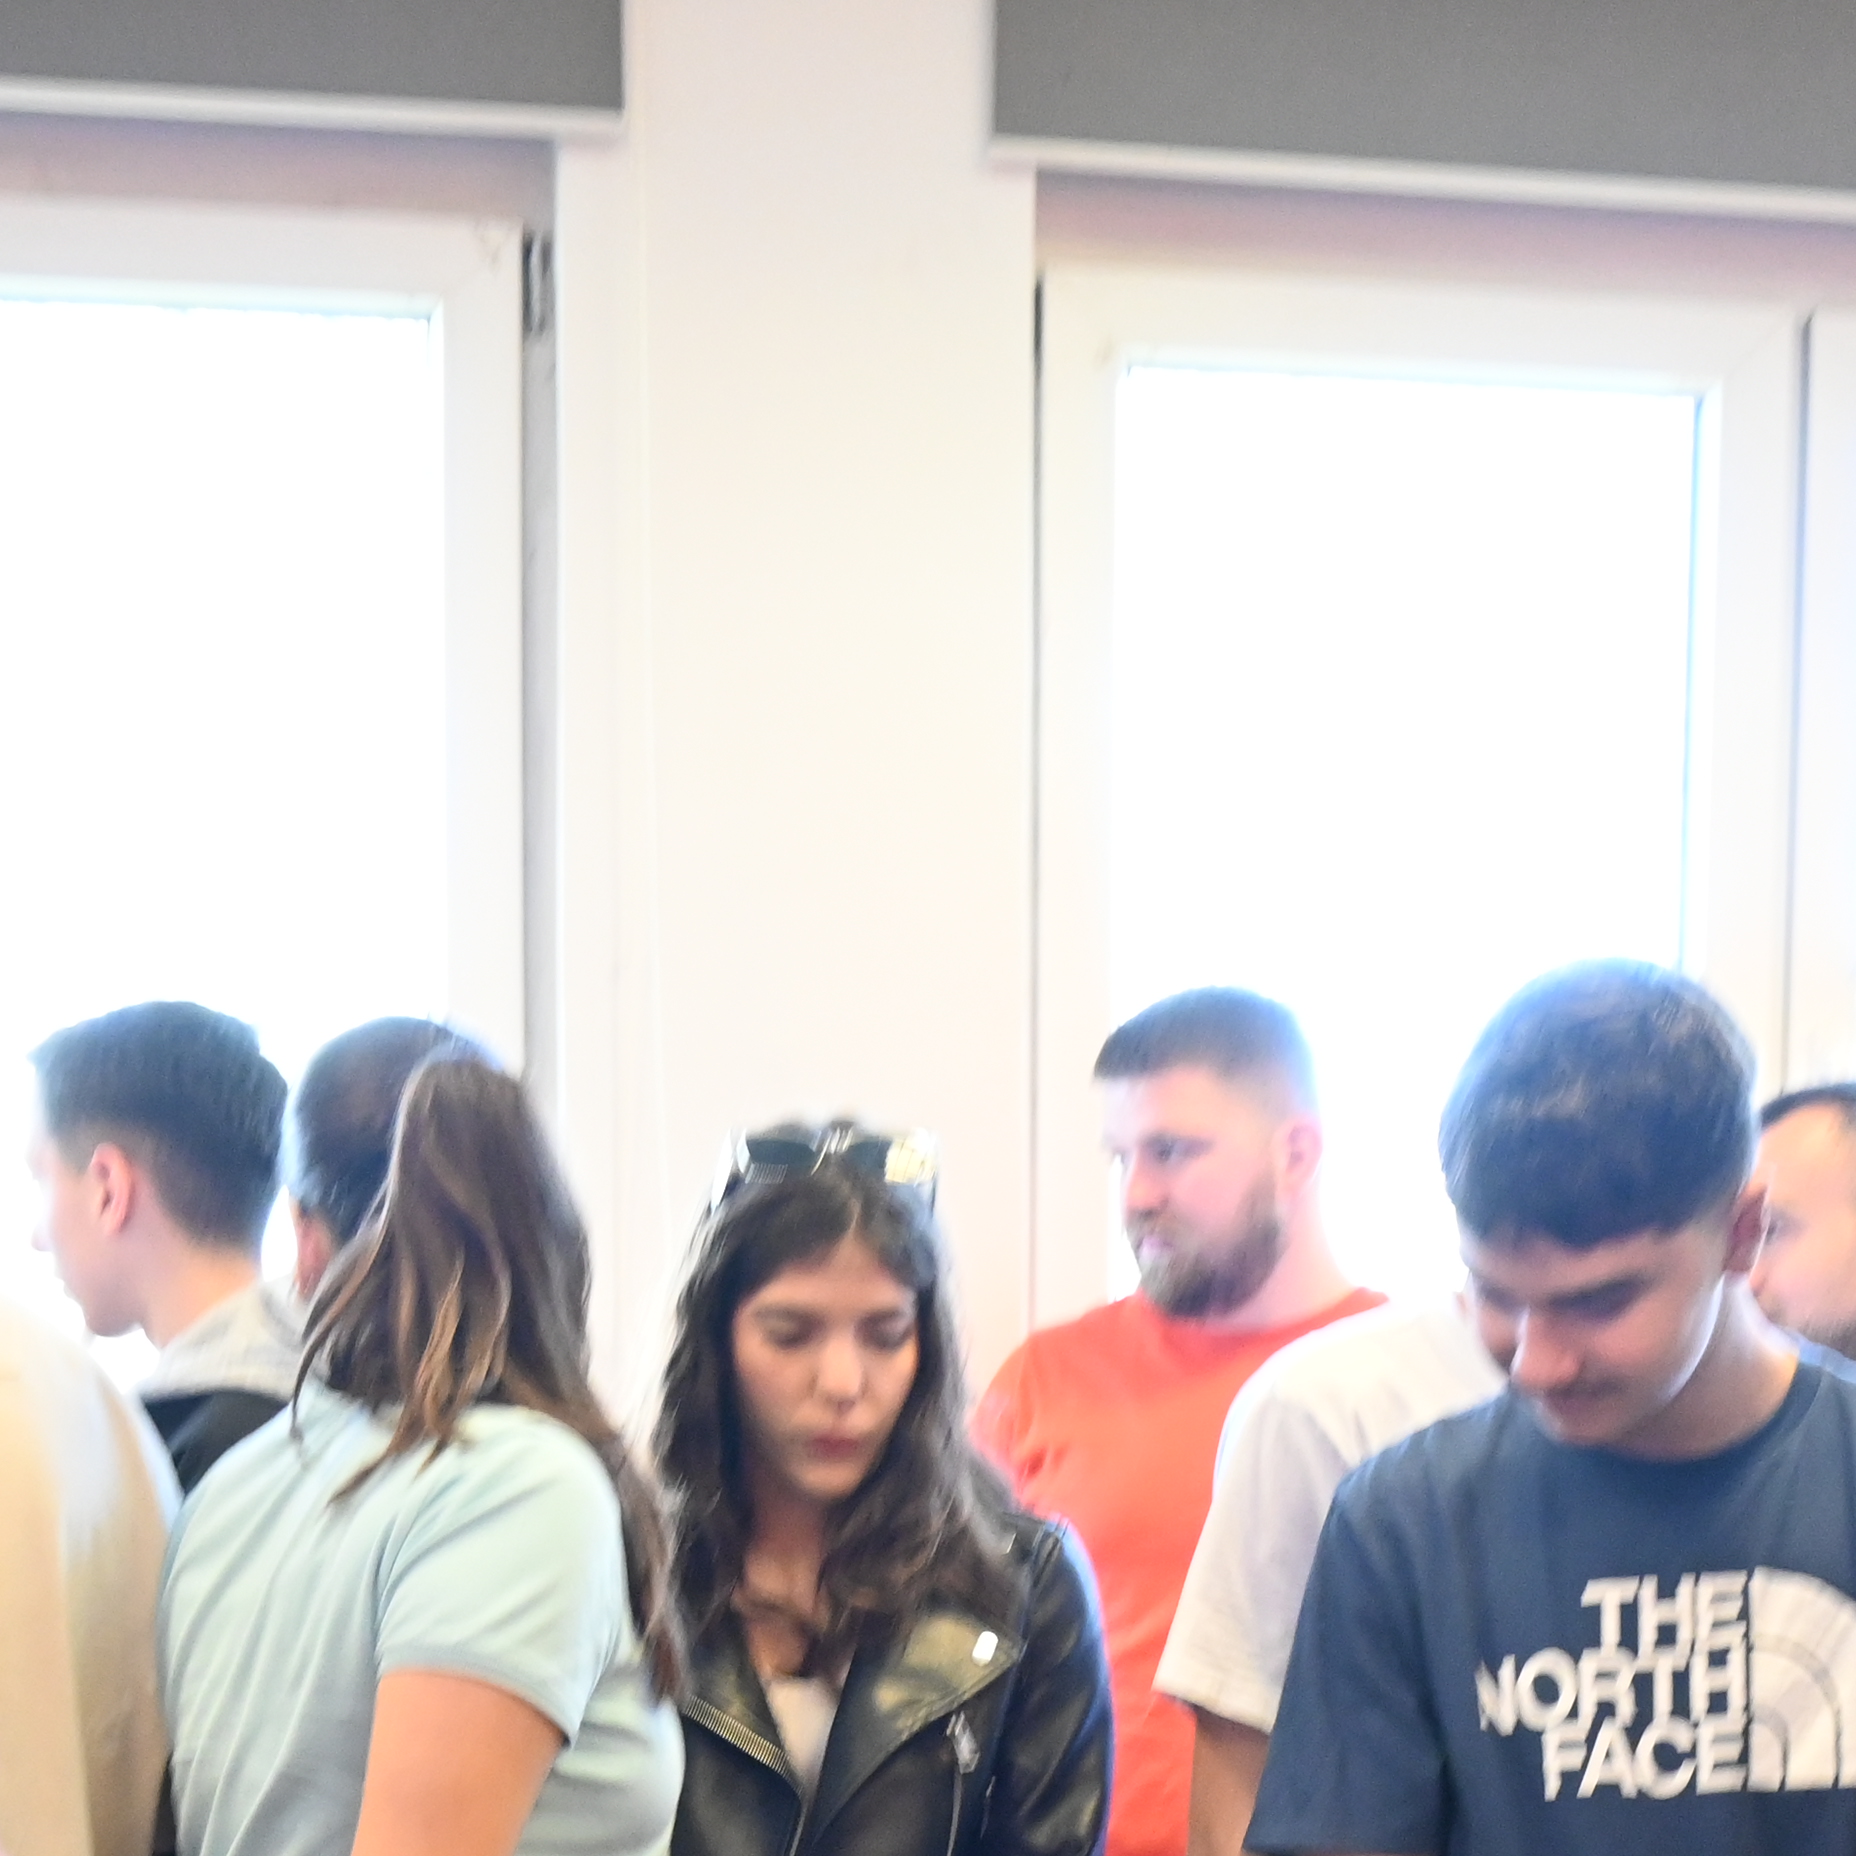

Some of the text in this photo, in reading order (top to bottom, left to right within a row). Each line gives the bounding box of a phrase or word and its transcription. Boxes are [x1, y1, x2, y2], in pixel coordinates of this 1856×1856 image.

[1581, 1569, 1747, 1657] THE
[1475, 1636, 1747, 1736] NORTH
[1541, 1712, 1746, 1801] FACE
